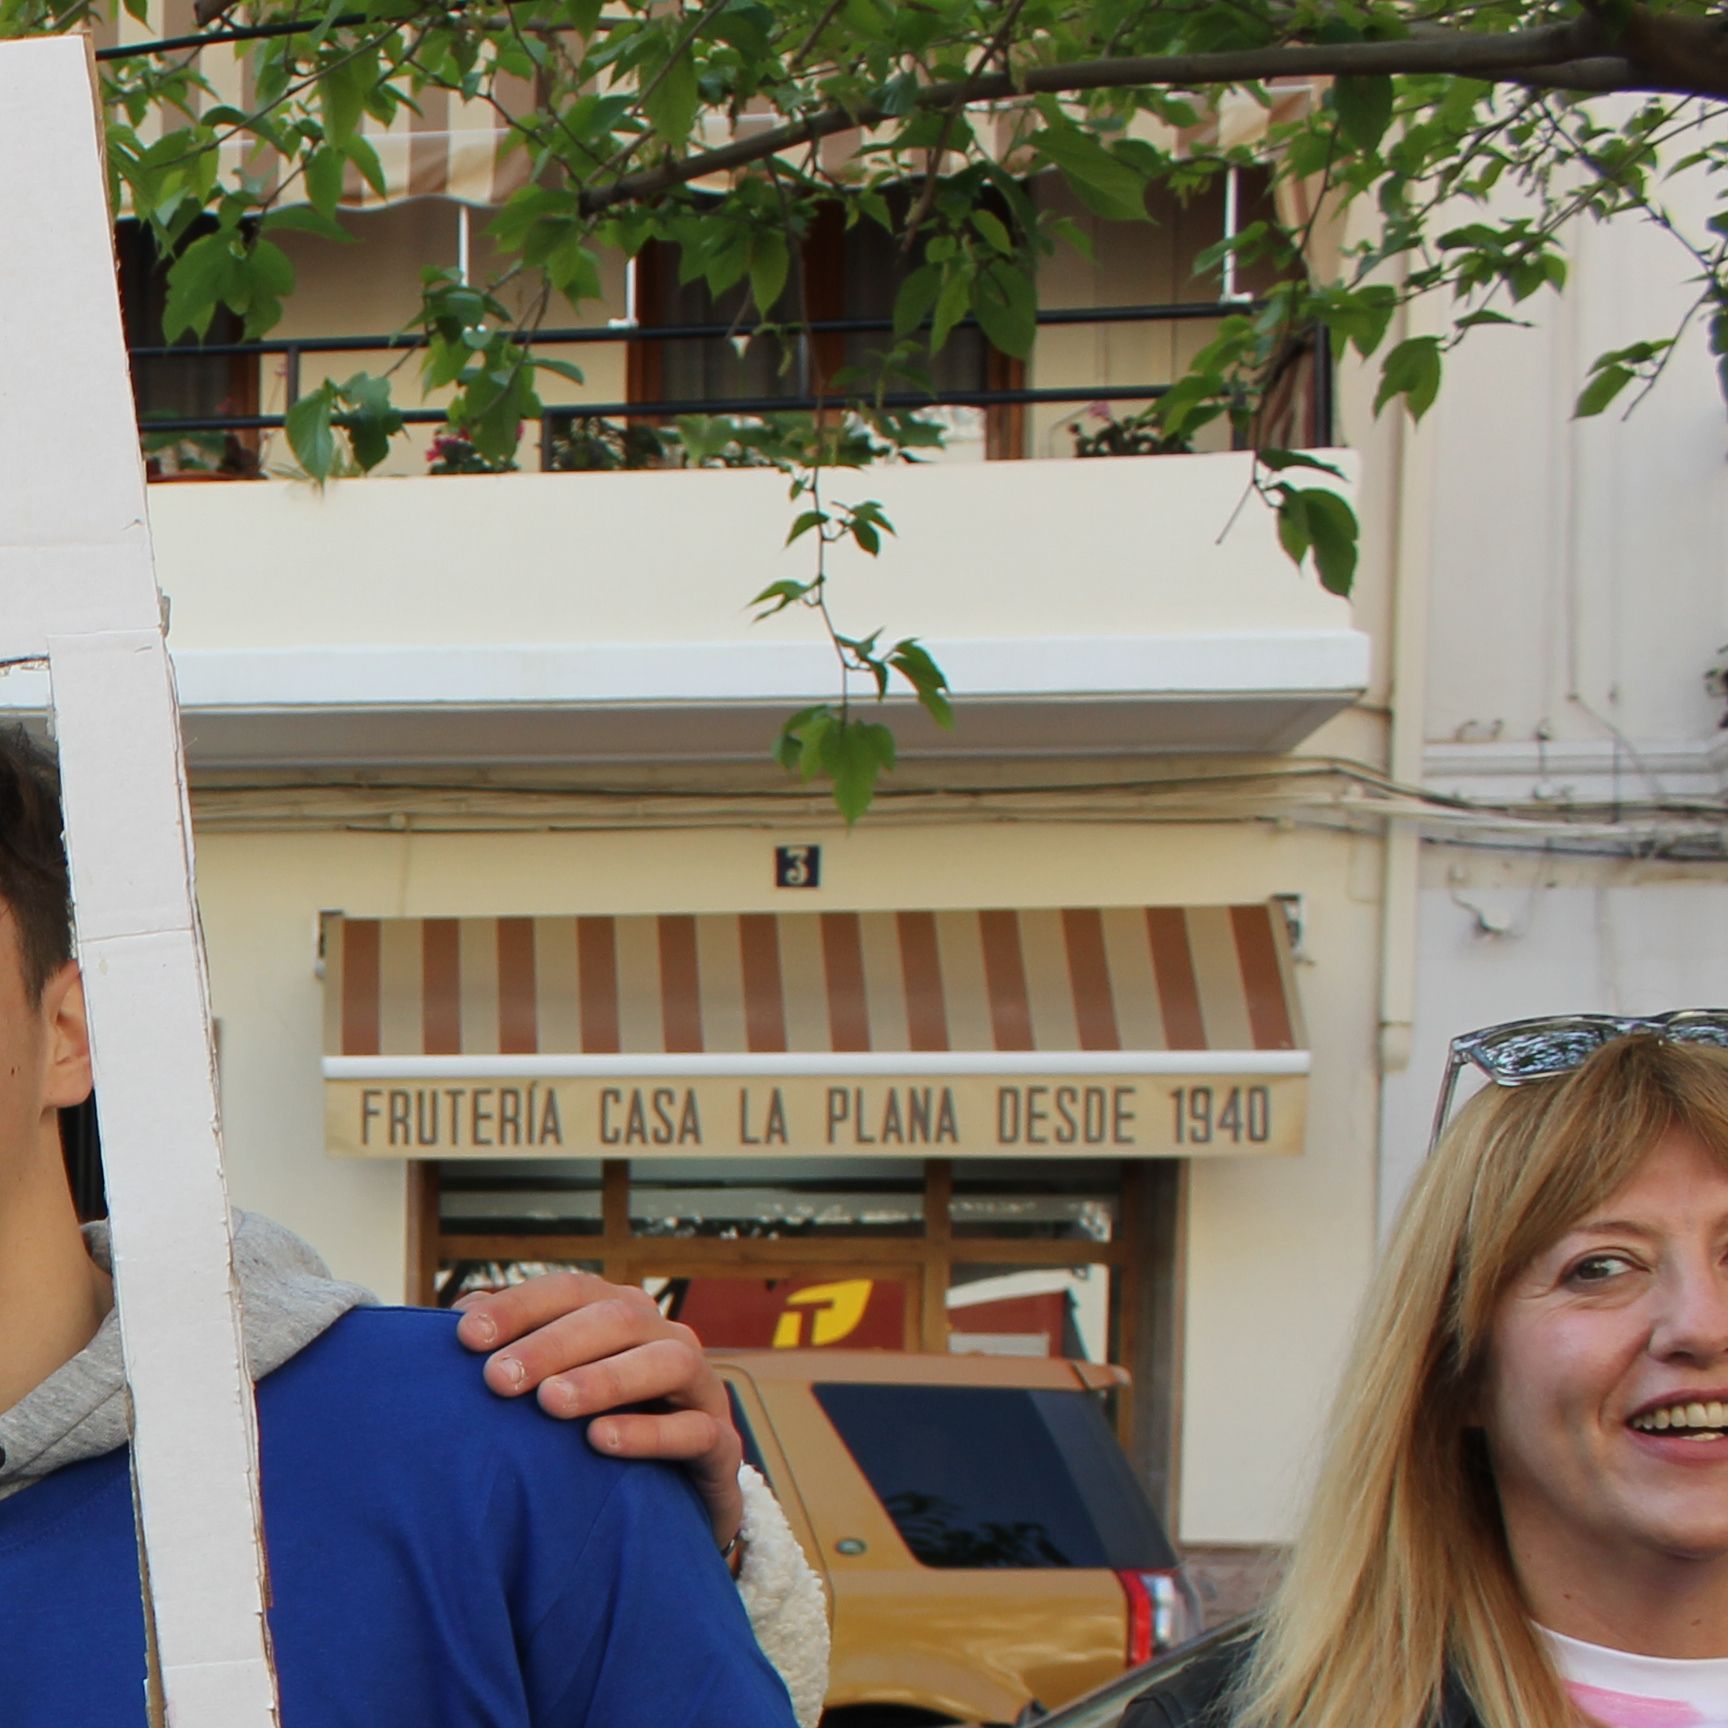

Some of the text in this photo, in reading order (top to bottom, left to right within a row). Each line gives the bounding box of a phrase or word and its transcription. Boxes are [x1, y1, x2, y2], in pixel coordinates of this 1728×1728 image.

[786, 848, 810, 885] 3
[360, 1080, 1272, 1147] FRUTERÍA CASA LA PLANA DESDE 1940
